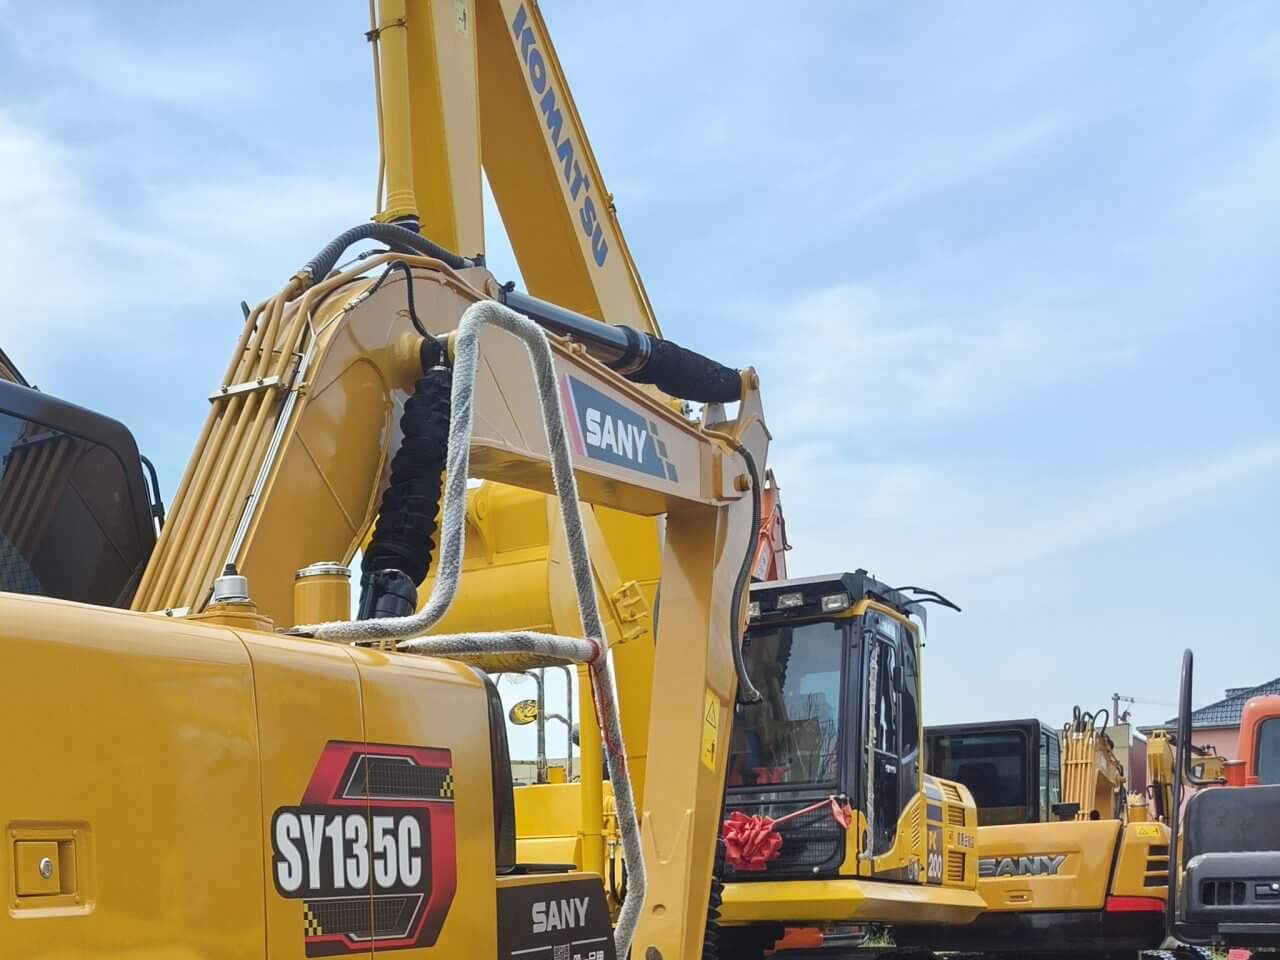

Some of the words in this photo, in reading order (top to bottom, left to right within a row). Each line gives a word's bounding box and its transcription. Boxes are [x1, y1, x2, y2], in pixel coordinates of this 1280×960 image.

[511, 5, 609, 268] KOMATSU
[586, 408, 646, 463] SANY
[275, 812, 421, 892] SY135C
[928, 852, 943, 878] 200
[531, 897, 589, 933] SANY
